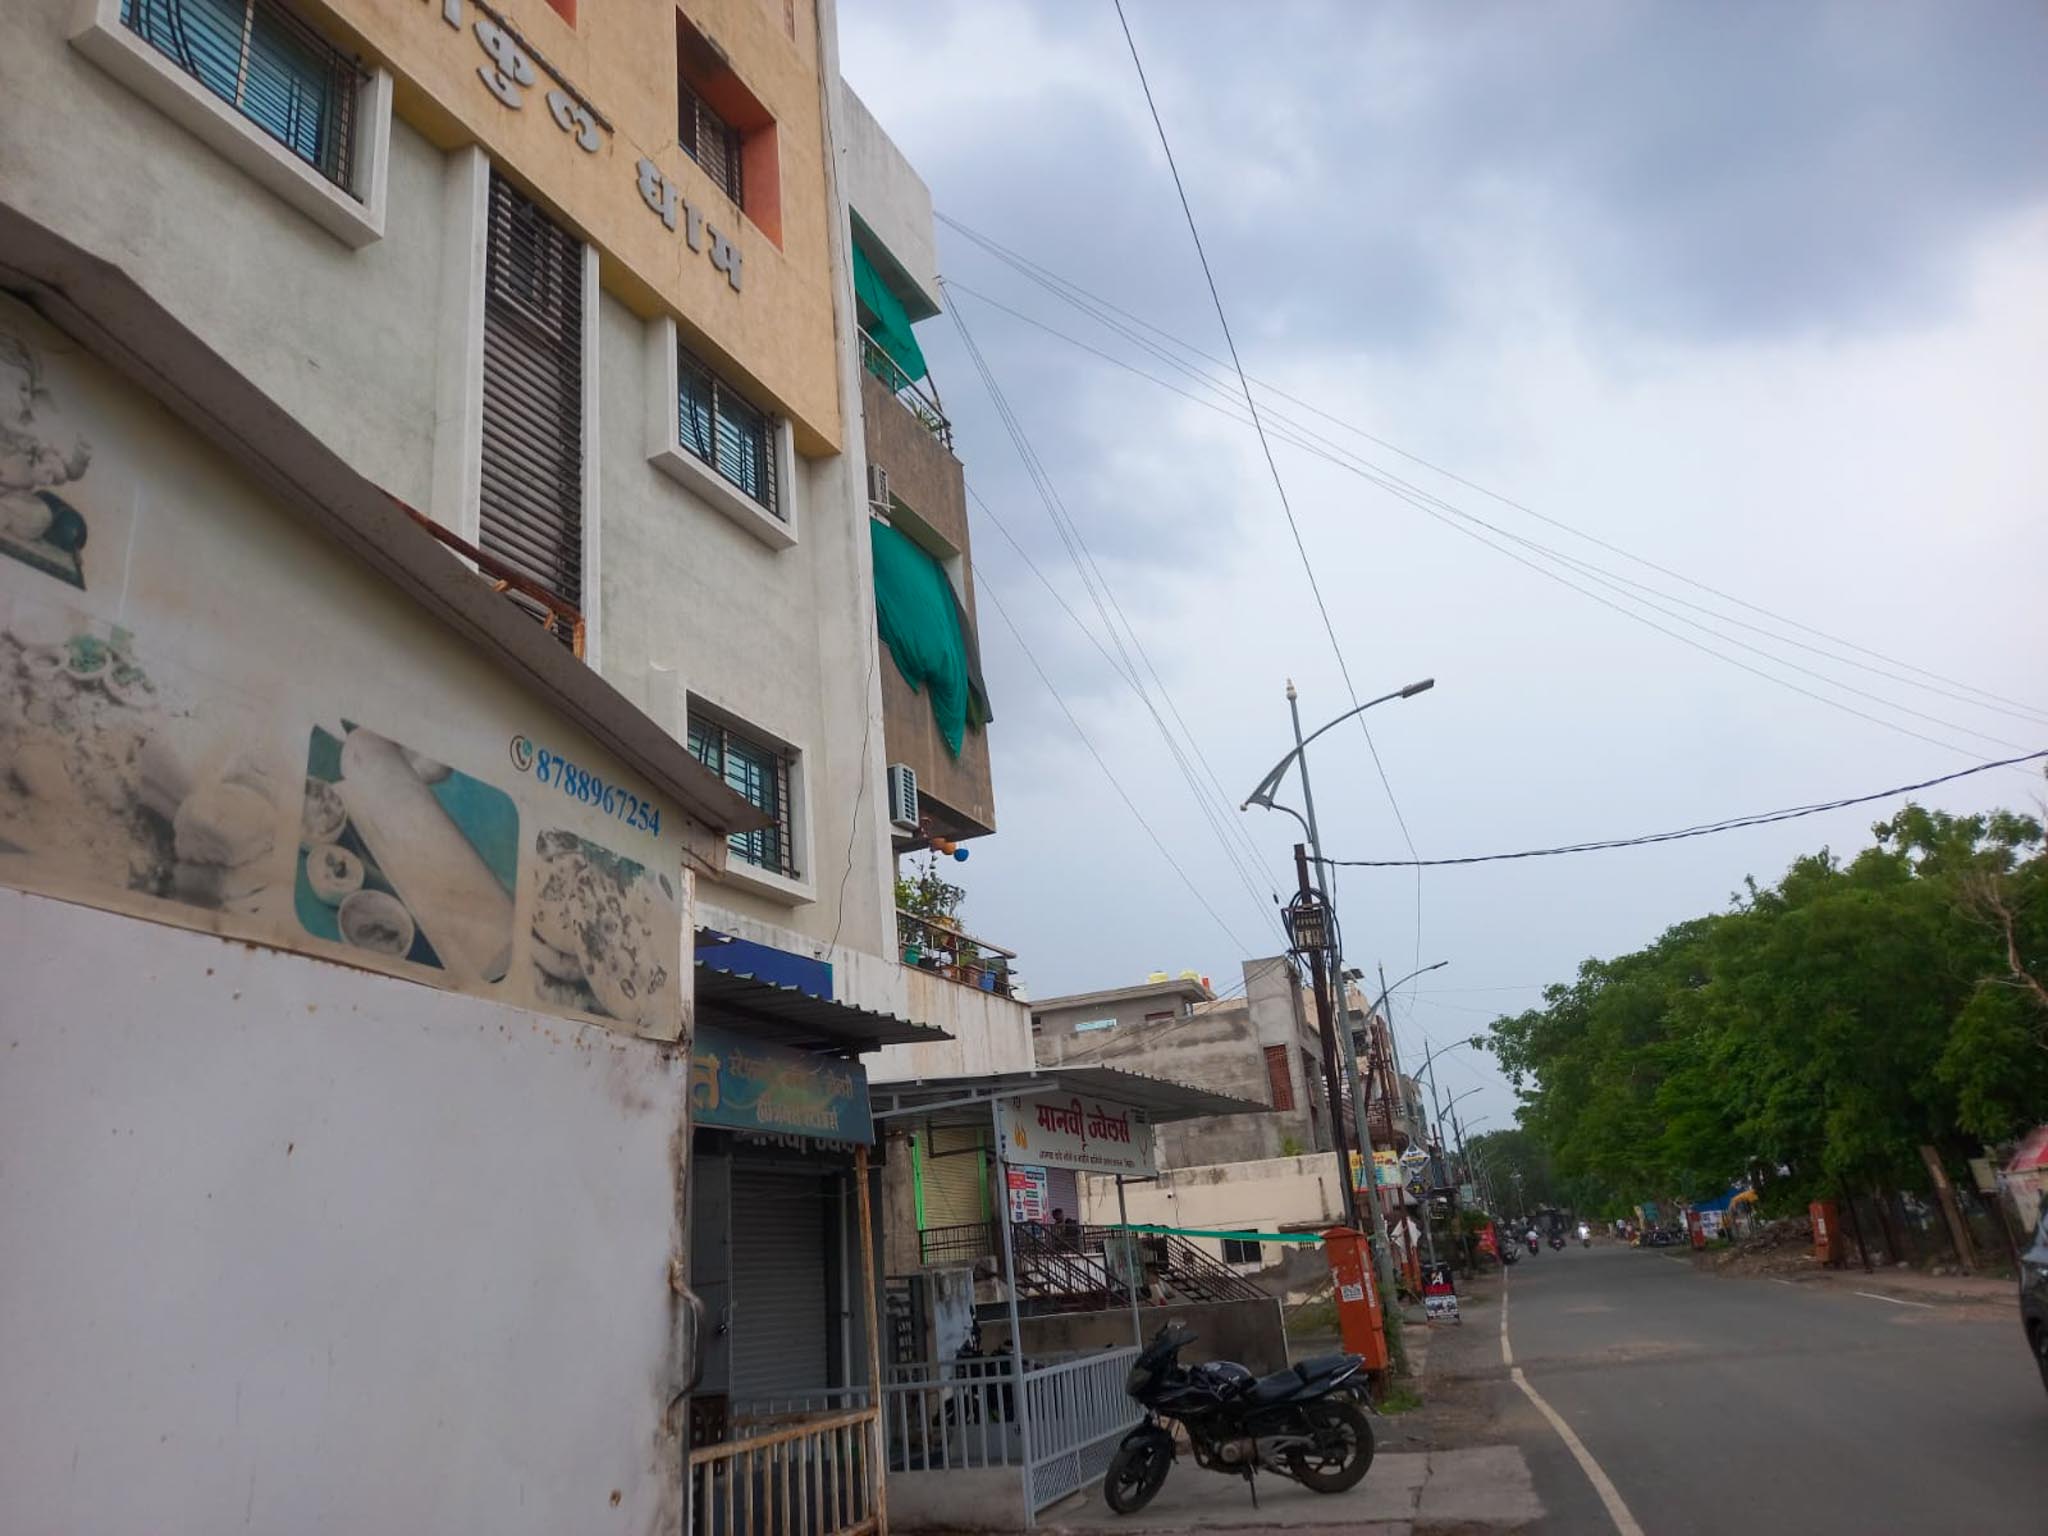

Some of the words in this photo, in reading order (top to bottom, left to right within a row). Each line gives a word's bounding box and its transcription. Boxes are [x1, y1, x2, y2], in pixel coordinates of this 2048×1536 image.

[635, 155, 743, 293] धाम
[536, 748, 661, 838] 8788967254
[1034, 1097, 1087, 1143] मानवी
